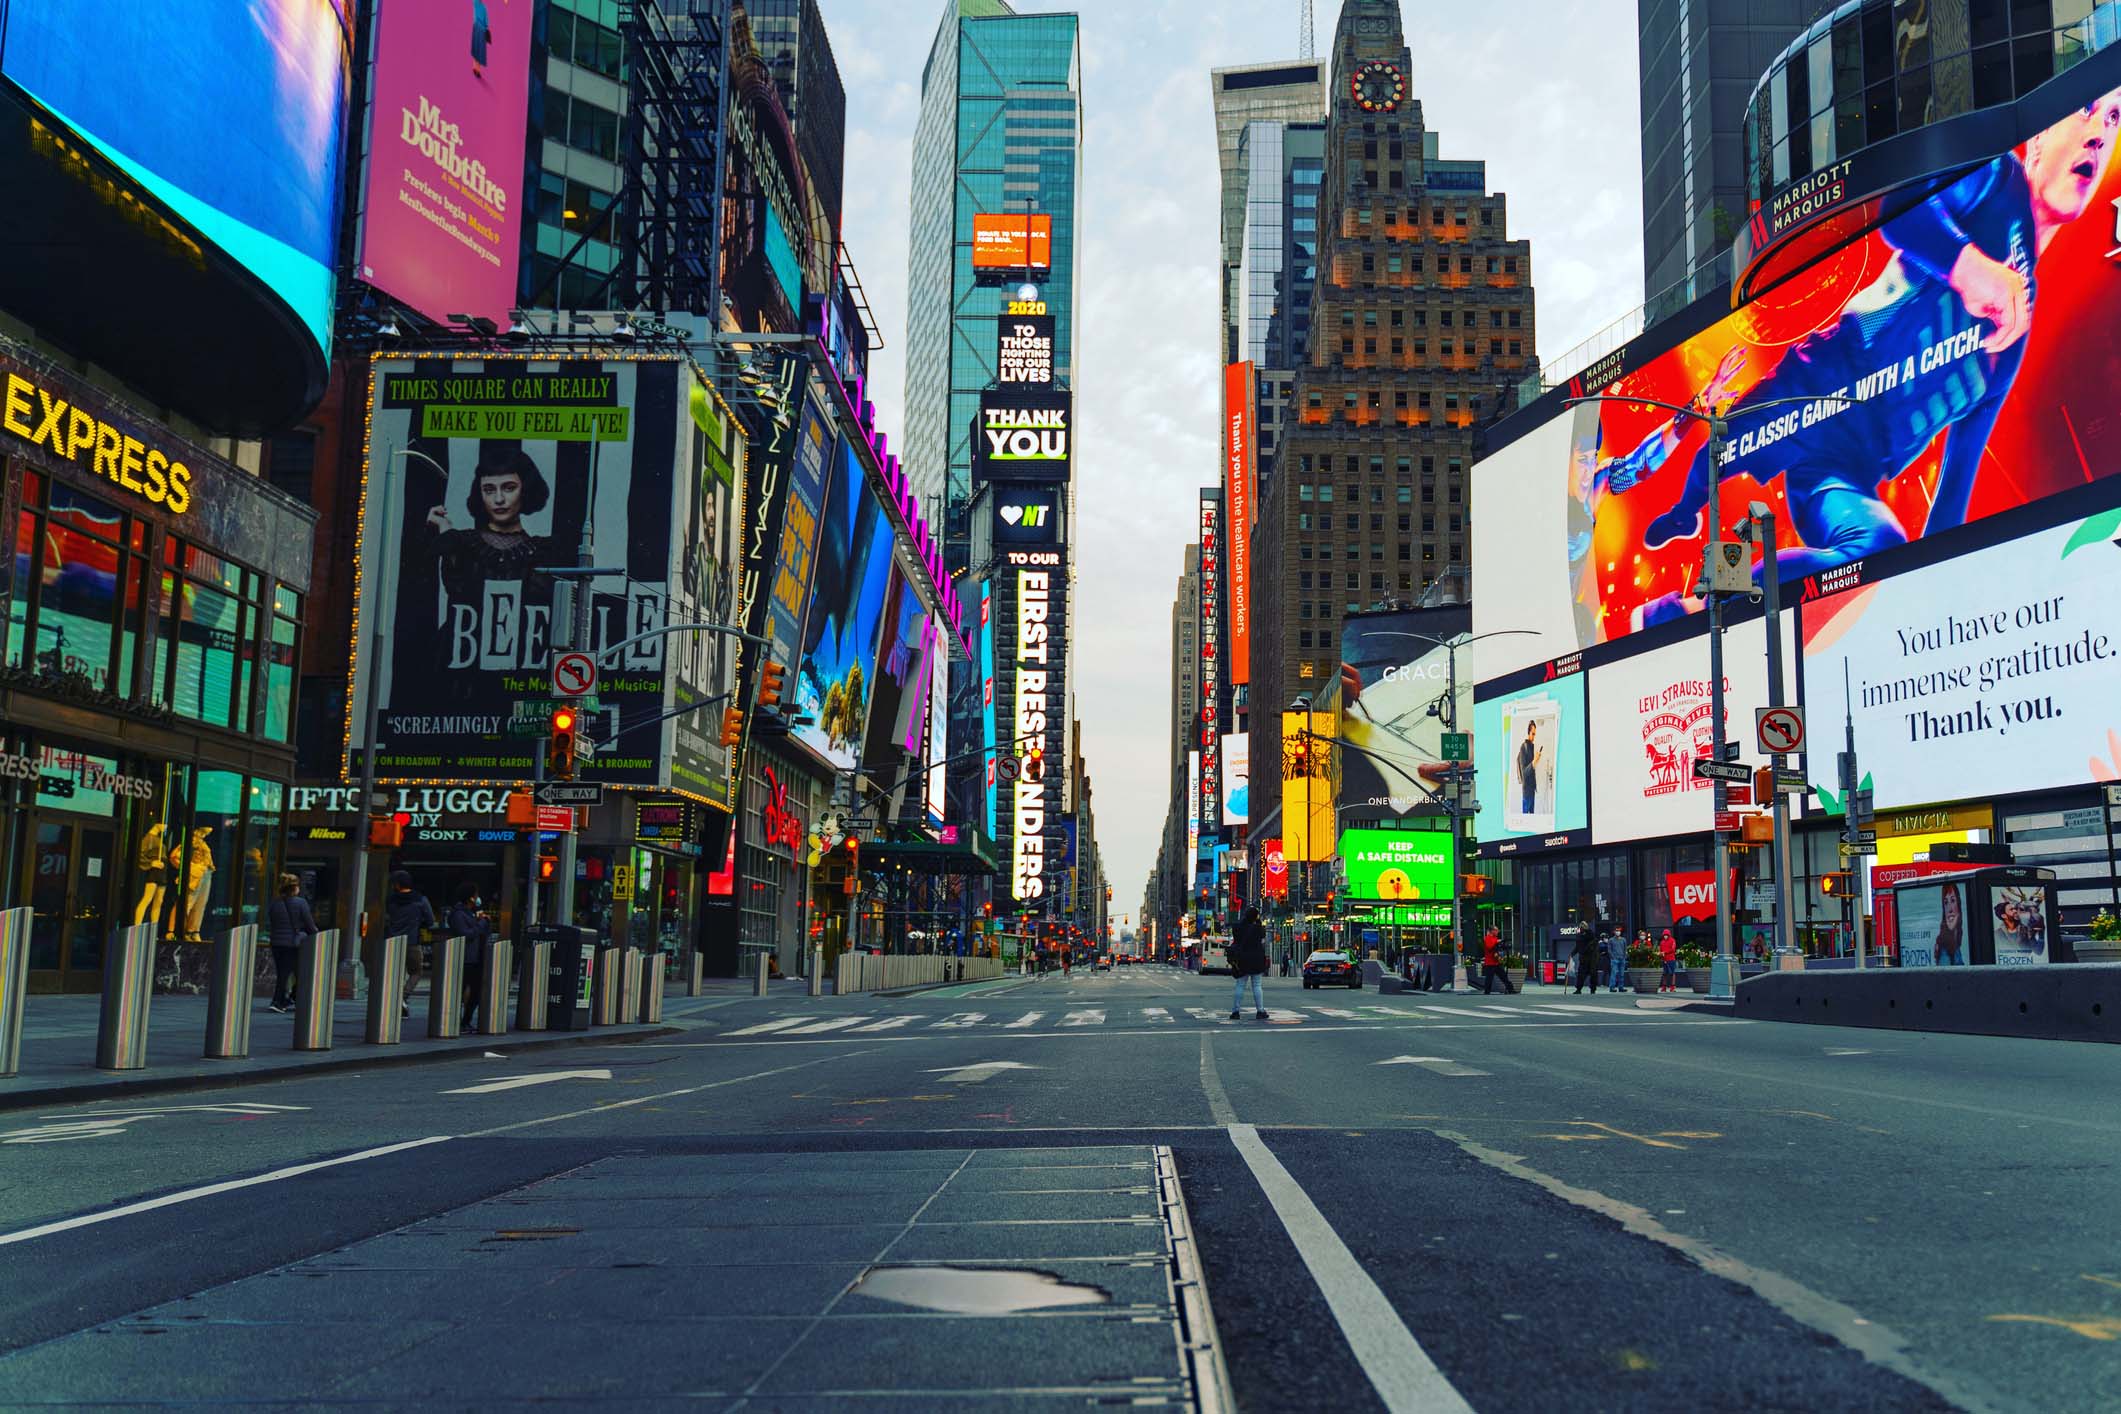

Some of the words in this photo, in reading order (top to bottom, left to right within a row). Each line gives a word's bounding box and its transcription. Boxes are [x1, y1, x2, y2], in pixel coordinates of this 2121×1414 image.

[419, 96, 463, 146] Mrs.
[401, 107, 506, 212] Doubtfire
[1773, 160, 1852, 214] MARRIOTT
[404, 168, 443, 205] Previews
[444, 196, 467, 223] begin
[468, 213, 494, 242] March
[494, 232, 500, 245] 9
[1774, 185, 1842, 233] MARQUIS
[1008, 301, 1046, 315] 2020
[636, 320, 688, 338] LAMAR
[1013, 324, 1035, 337] TO
[1001, 337, 1050, 349] THOSE
[1001, 349, 1050, 358] FIGHTING
[1001, 358, 1024, 368] FOR
[1025, 358, 1050, 368] OUR
[1586, 348, 1627, 380] MARRIOTT
[1000, 368, 1050, 382] LIVES
[1586, 364, 1623, 393] MARQUIS
[390, 379, 439, 400] TIMES
[443, 378, 506, 403] SQUARE
[512, 377, 544, 400] CAN
[550, 377, 611, 399] REALLY
[1718, 438, 1736, 466] HE
[1740, 412, 1798, 457] CLASSIC
[1855, 365, 1898, 402] WITH
[1901, 359, 1915, 384] A
[1920, 324, 1985, 374] CATCH.
[430, 410, 478, 432] MAKE
[485, 411, 516, 433] YOU
[523, 412, 563, 433] FEEL
[570, 412, 623, 434] ALIVE!
[985, 408, 1066, 427] THANK
[1232, 411, 1242, 453] Thank
[3, 372, 191, 514] EXPRESS
[985, 429, 1066, 458] YOU
[1232, 456, 1241, 479] you
[1233, 480, 1242, 493] to
[1233, 494, 1243, 517] the
[1008, 552, 1028, 565] TO
[1029, 553, 1060, 565] OUR
[1234, 518, 1244, 583] healthcare
[1821, 561, 1864, 583] MARRIOTT
[1822, 574, 1859, 594] MARQUIS
[1022, 571, 1048, 665] FIRST
[1236, 585, 1244, 637] workers.
[448, 580, 667, 673] BEELE
[1897, 625, 1941, 657] You
[1949, 609, 2007, 645] have
[2015, 596, 2064, 629] our
[1556, 653, 1583, 667] MARRIOTT
[1556, 662, 1580, 676] MARQUIS
[1861, 664, 1972, 708] immense
[1979, 629, 2117, 693] gratitude.
[503, 678, 525, 692] The
[614, 678, 665, 692] Musical.
[1640, 694, 1659, 714] LEVI
[1662, 680, 1704, 707] STRAUSS
[1722, 676, 1732, 693] O.
[525, 703, 535, 716] W
[539, 702, 552, 716] 46
[1643, 715, 1684, 737] ORIGINAL
[1904, 700, 1993, 743] Thank
[1999, 695, 2062, 736] you.
[1451, 735, 1459, 743] TO
[1654, 734, 1673, 746] QUALITY
[1692, 726, 1713, 737] CLOTHIN
[380, 756, 393, 766] ON
[395, 756, 441, 767] BROADWAY
[466, 757, 496, 767] WINTER
[499, 757, 533, 768] GARDEN
[597, 758, 603, 768] &
[606, 758, 653, 769] BROADWAY
[1702, 765, 1720, 774] ONE
[1726, 767, 1745, 777] WAY
[83, 766, 153, 800] EXPRESS
[1646, 786, 1674, 797] PATENTED
[289, 787, 361, 812] IFTS
[396, 788, 512, 814] LUGGA
[543, 788, 562, 799] ONE
[572, 789, 592, 799] WAY
[410, 813, 442, 827] NY
[1894, 811, 1951, 832] INVICTA
[308, 827, 346, 839] Nikon
[419, 830, 468, 841] SONY
[478, 830, 516, 841] BOWER
[1544, 836, 1564, 847] swatch
[1388, 842, 1414, 851] KEEP
[1357, 852, 1365, 861] A
[1367, 853, 1392, 862] SAFE
[1395, 853, 1445, 863] DISTANCE
[1913, 853, 1930, 861] SHOP
[617, 867, 626, 896] ATM
[1901, 949, 1932, 967] FROZEN
[1997, 955, 2033, 966] FROZEN
